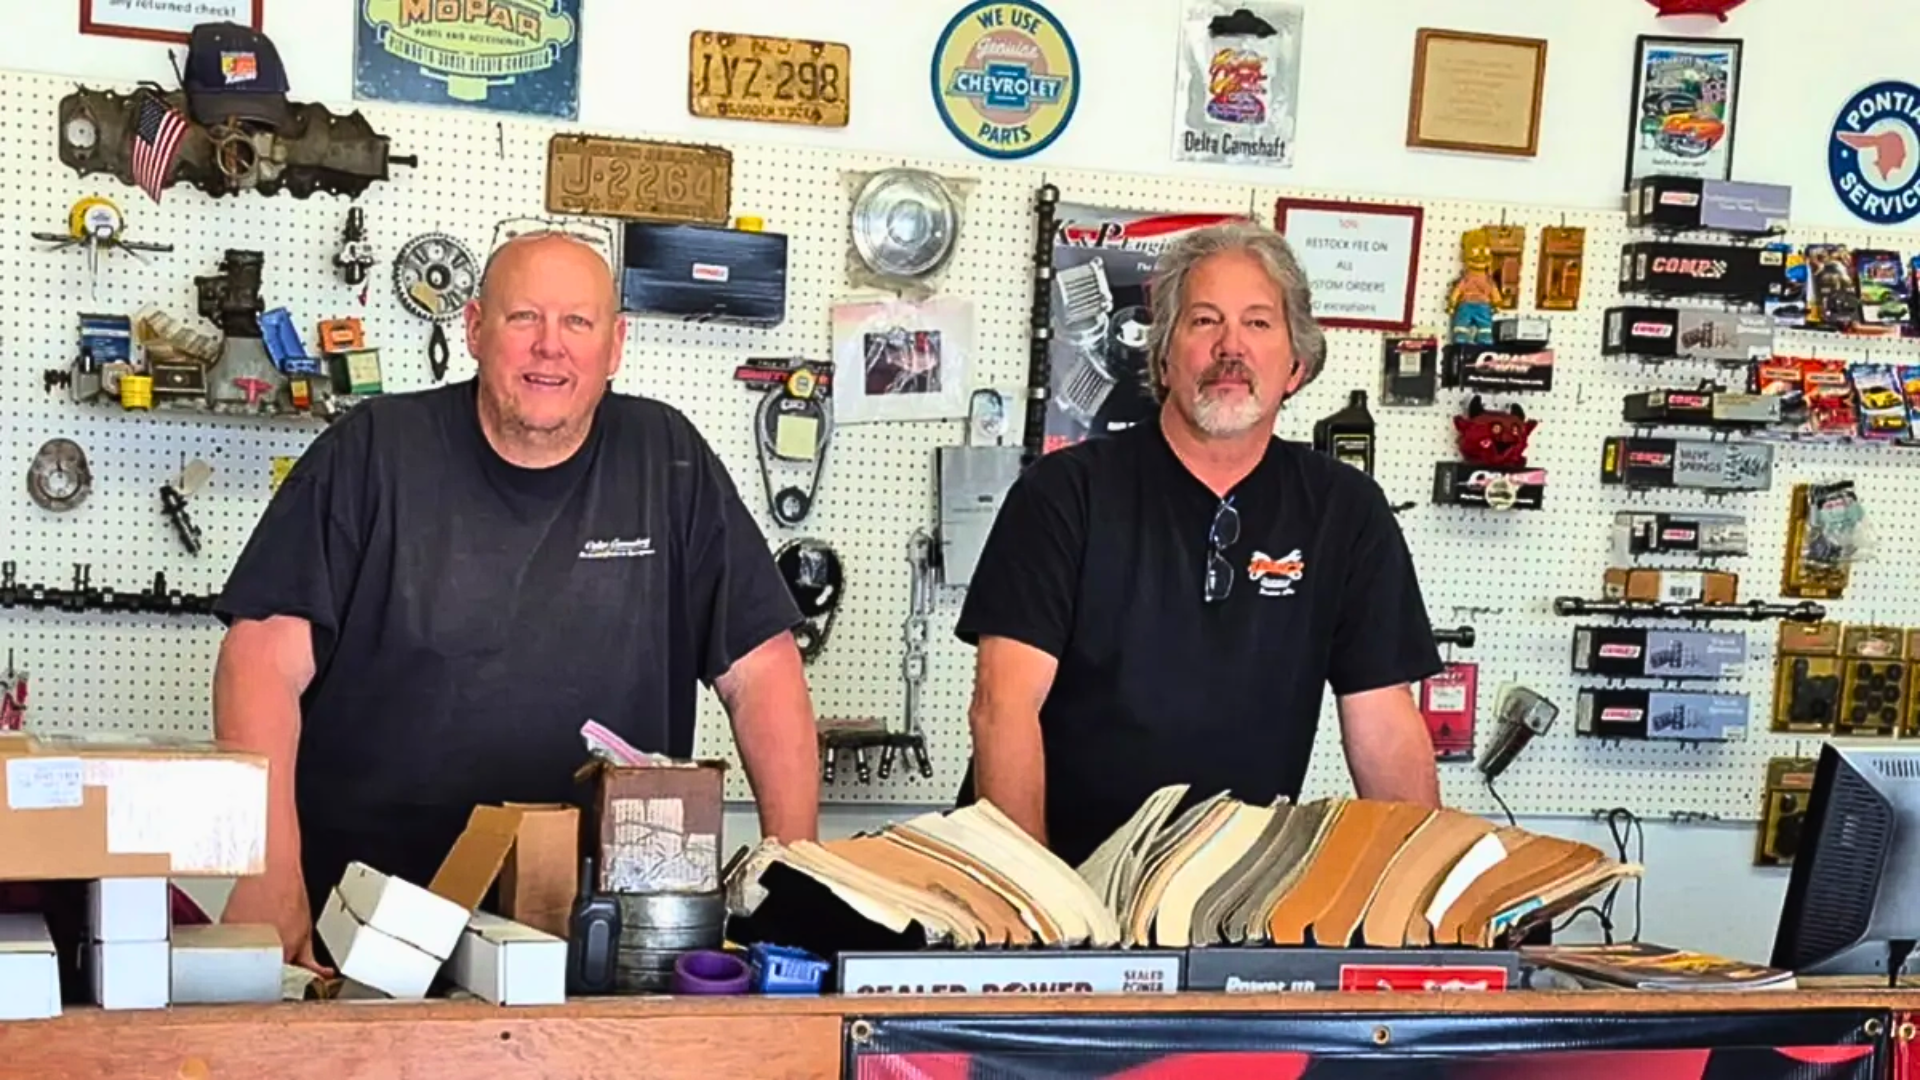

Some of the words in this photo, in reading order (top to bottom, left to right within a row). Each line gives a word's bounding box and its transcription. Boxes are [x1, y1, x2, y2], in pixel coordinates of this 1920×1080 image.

[136, 0, 191, 13] returned
[195, 3, 236, 17] check!
[399, 0, 542, 43] MOPAR
[976, 8, 1004, 29] WE
[1010, 8, 1043, 35] USE
[957, 74, 1057, 97] CHEVROLET
[977, 122, 1032, 145] PARTS
[1184, 130, 1219, 154] Delta
[1221, 133, 1286, 158] Camshaft
[1305, 236, 1349, 249] RESTOCK
[1352, 240, 1369, 251] FEE
[1371, 241, 1388, 252] ON
[1336, 259, 1353, 271] ALL
[1345, 281, 1385, 293] ORDERS
[1123, 969, 1164, 980] SEALED
